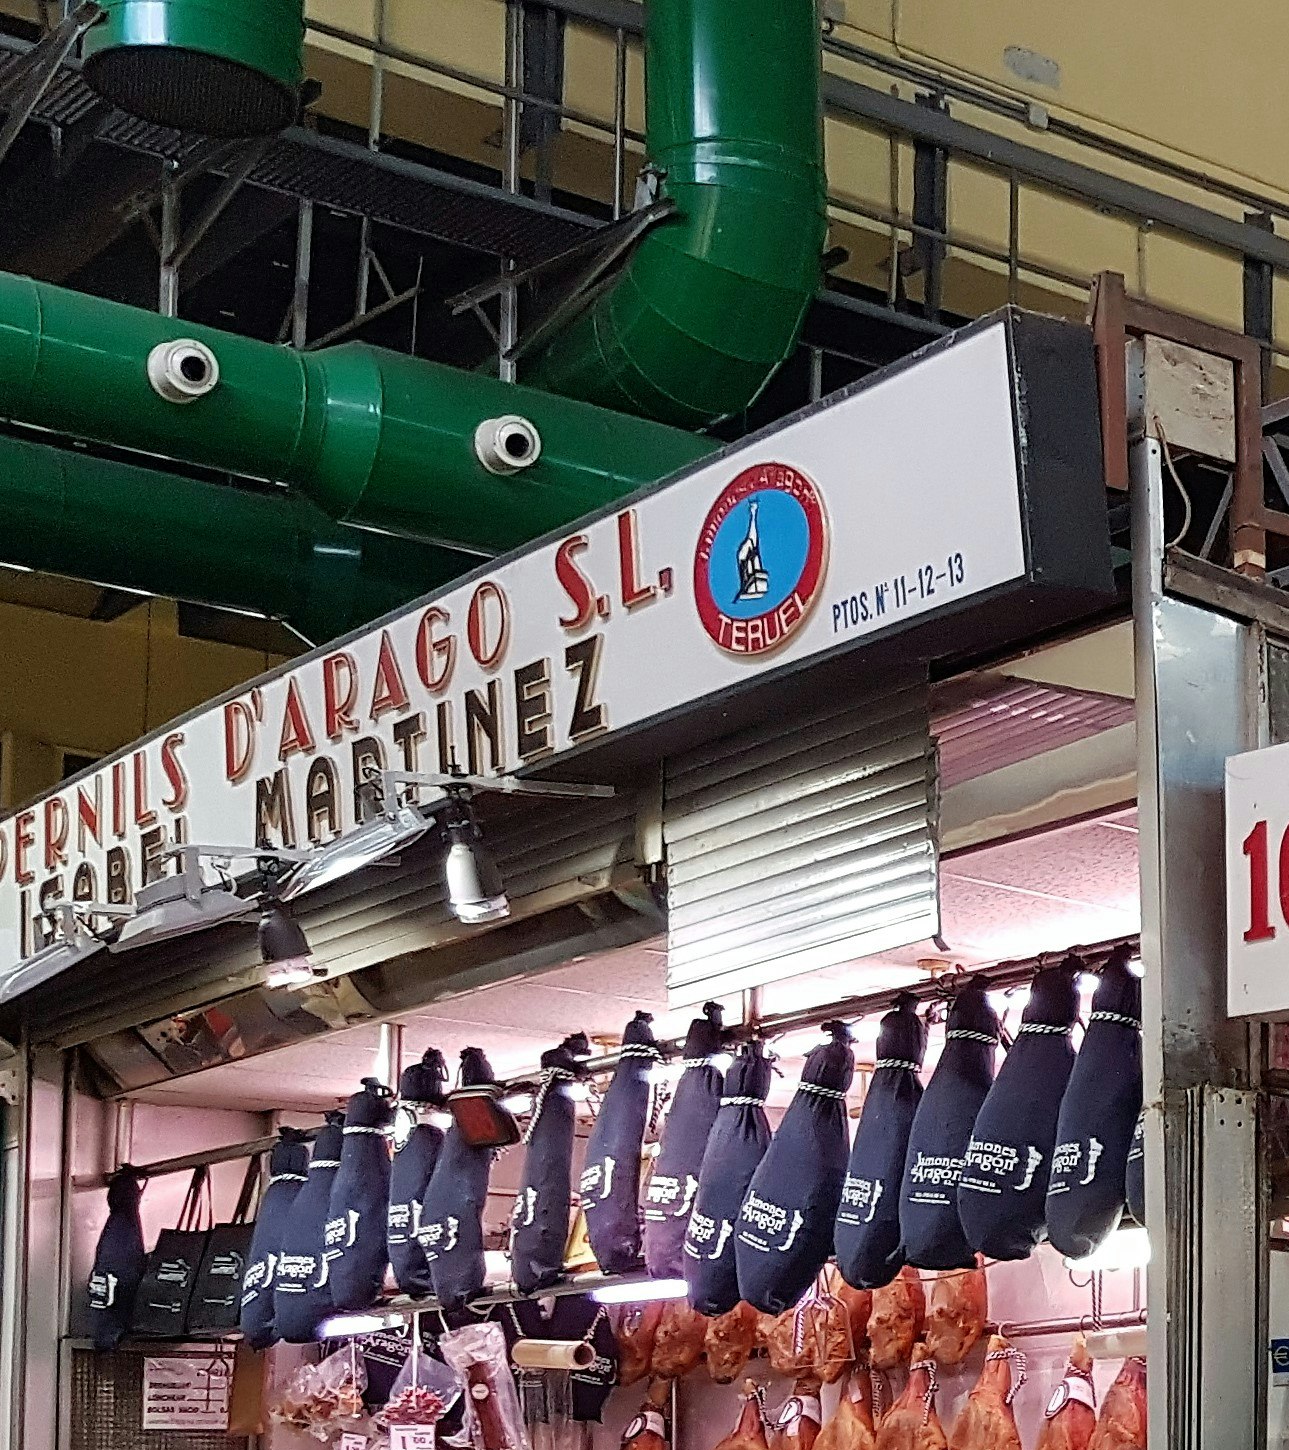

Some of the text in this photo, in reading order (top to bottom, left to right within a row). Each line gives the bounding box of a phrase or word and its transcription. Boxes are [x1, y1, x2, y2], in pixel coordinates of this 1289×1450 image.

[717, 591, 811, 652] TERUEL
[831, 593, 874, 634] PTOS.
[892, 552, 965, 609] 11-12-13
[0, 731, 190, 887] ERNILS
[223, 580, 512, 785] D'ARAGO
[254, 631, 608, 850] MARTINEZ
